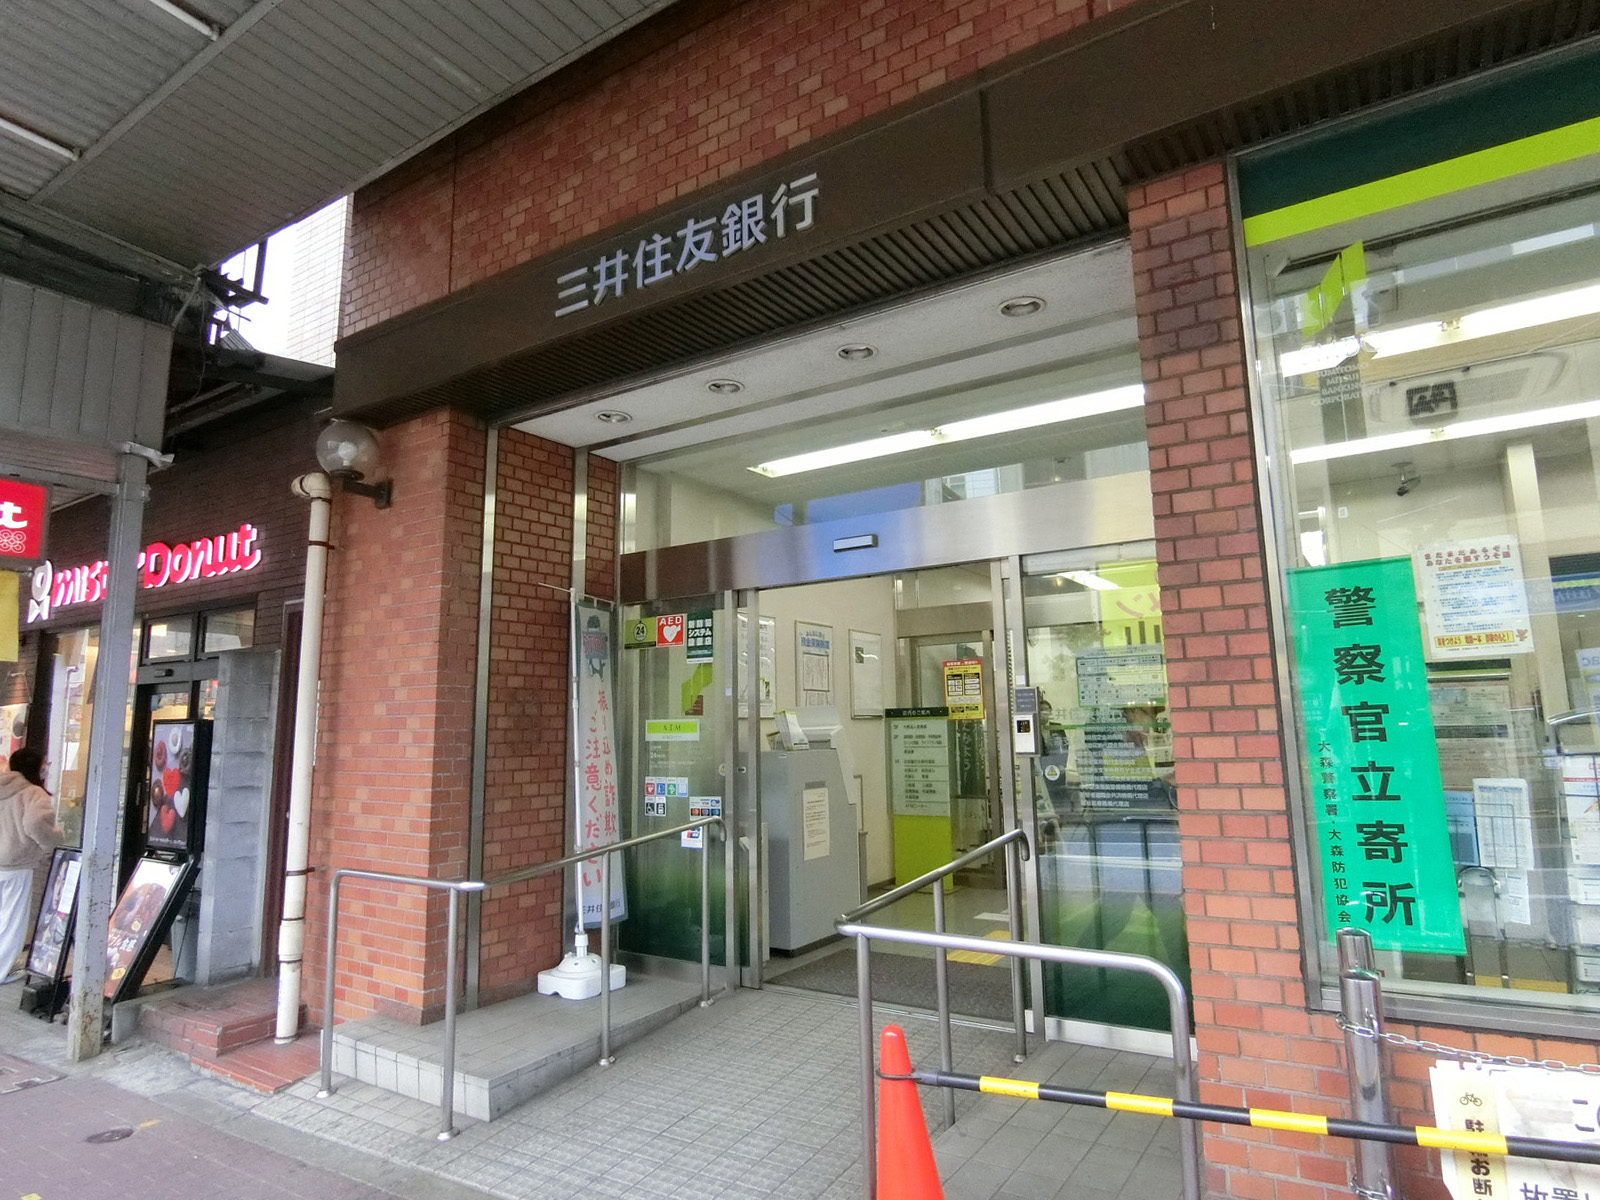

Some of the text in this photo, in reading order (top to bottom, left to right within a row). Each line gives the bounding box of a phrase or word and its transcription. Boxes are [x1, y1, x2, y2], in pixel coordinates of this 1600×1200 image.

[554, 172, 820, 318] 三井住友銀行
[143, 523, 262, 589] Donut
[635, 626, 645, 635] 24
[659, 616, 682, 626] AED
[1323, 585, 1417, 926] 警察官立寄所
[1317, 741, 1351, 923] 大森警察署・大森防犯協会
